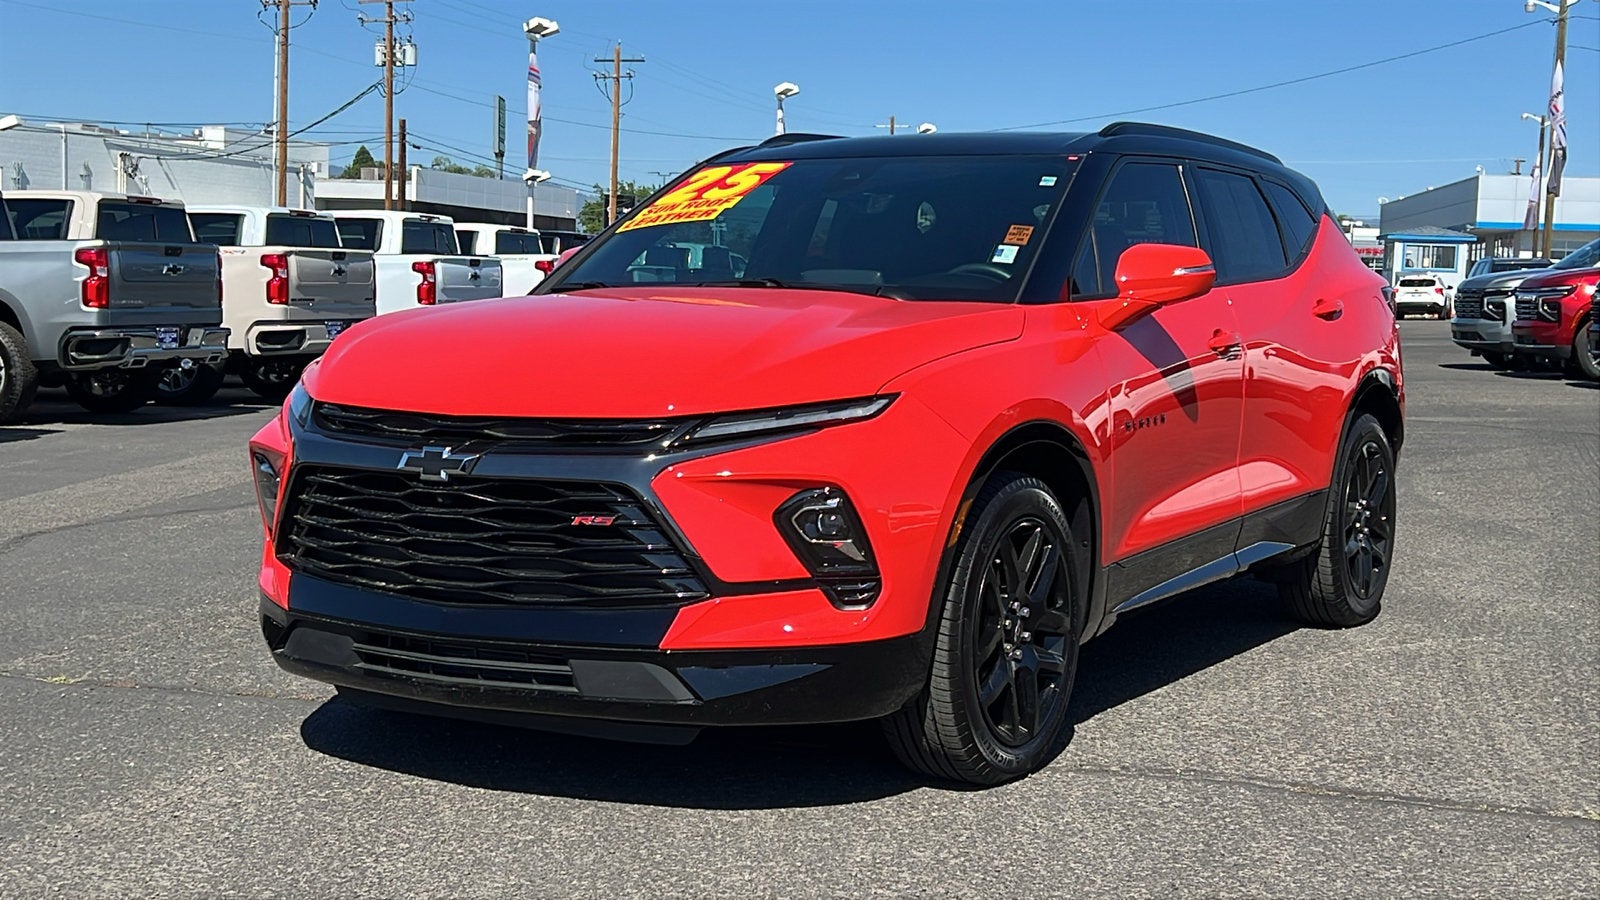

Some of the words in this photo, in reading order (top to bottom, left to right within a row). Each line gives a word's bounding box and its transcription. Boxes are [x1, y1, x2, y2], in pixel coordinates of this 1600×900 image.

[654, 163, 786, 205] 25
[642, 204, 677, 216] SUN
[682, 198, 735, 211] ROOF
[624, 208, 718, 229] LEATHER
[571, 516, 614, 526] RS
